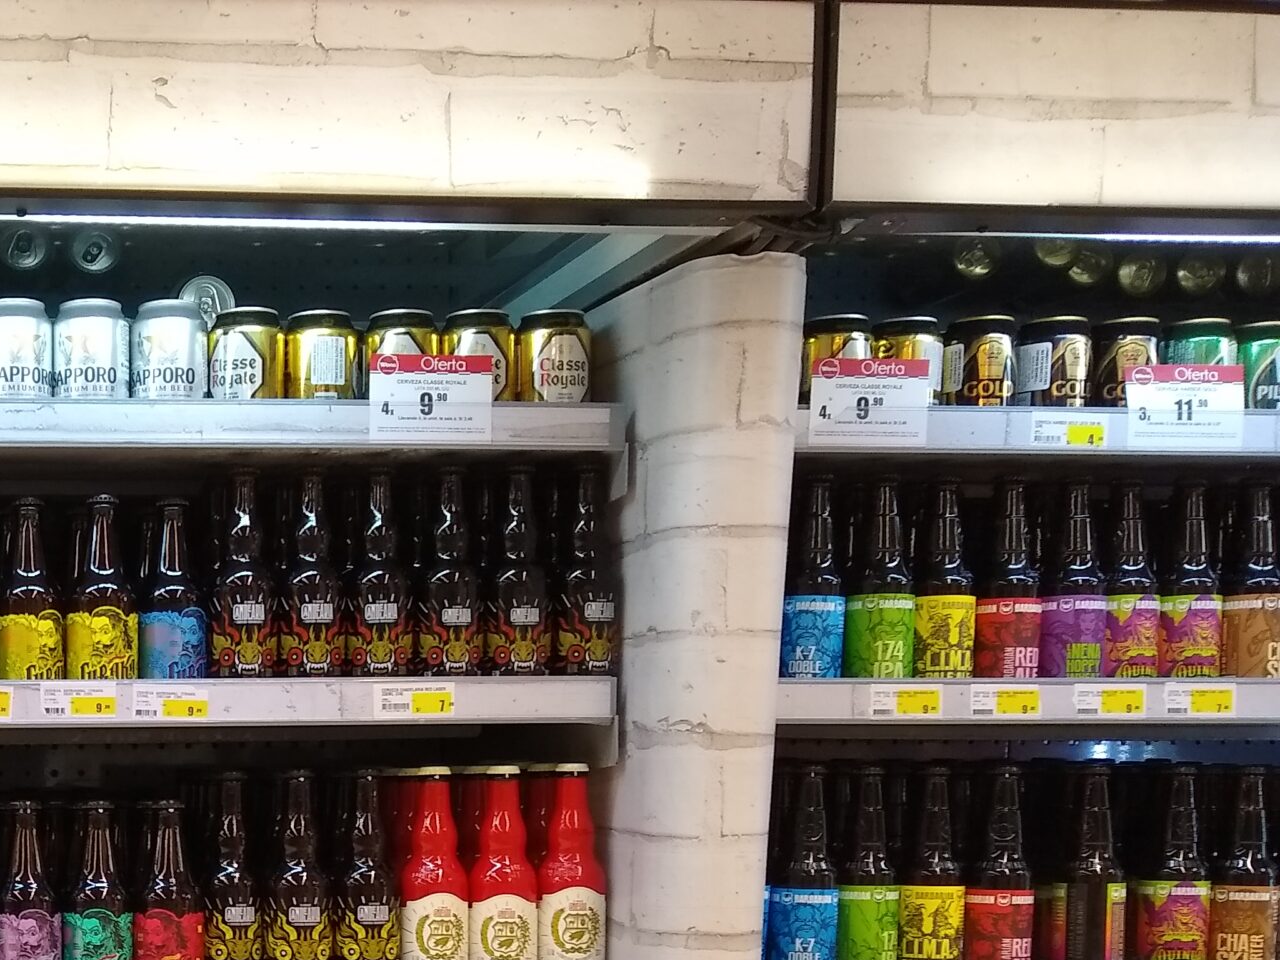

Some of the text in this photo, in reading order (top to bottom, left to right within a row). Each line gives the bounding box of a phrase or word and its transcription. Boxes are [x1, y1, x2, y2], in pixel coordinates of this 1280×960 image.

[421, 357, 466, 370] Oferta
[540, 358, 586, 372] Classe
[861, 360, 905, 374] Oferta
[540, 373, 586, 389] Royale
[1175, 367, 1218, 380] Oferta
[964, 380, 1013, 396] GOLD
[795, 645, 816, 660] K-7
[876, 640, 904, 660] 174
[1016, 647, 1039, 667] RED
[788, 661, 821, 673] DOBLE
[874, 662, 903, 678] IPA
[795, 938, 815, 952] K-7
[902, 939, 950, 959] LIMA
[1217, 933, 1249, 951] CHA
